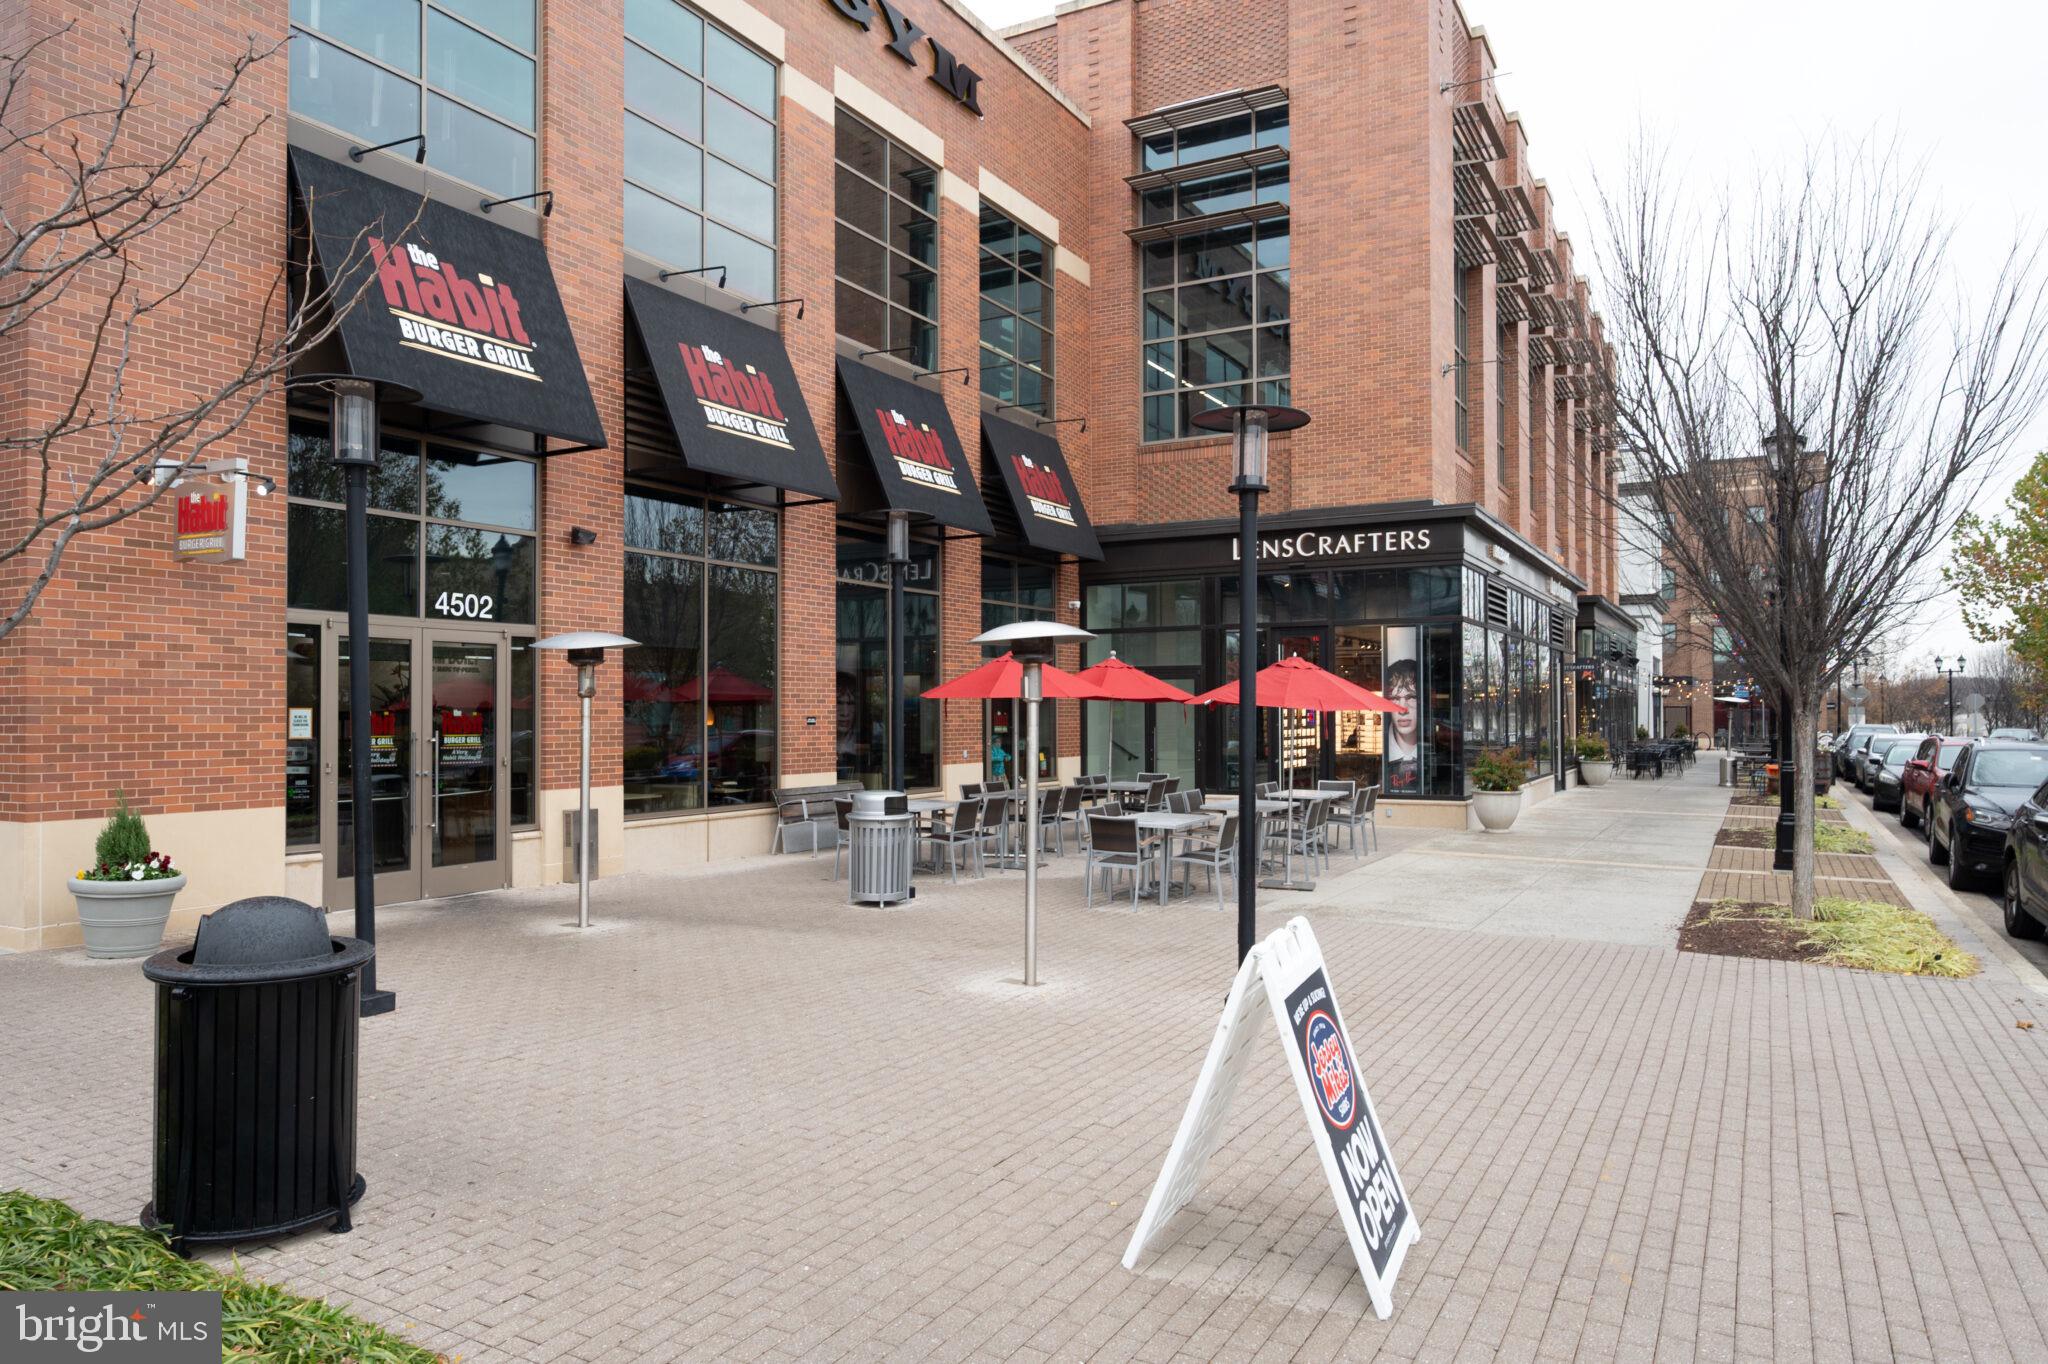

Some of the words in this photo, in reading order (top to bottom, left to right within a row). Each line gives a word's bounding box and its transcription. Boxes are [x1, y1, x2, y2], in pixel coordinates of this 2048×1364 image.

[407, 243, 440, 271] the
[367, 236, 531, 346] Habit
[399, 318, 481, 358] BURGER
[483, 342, 534, 373] GRILL
[701, 344, 723, 366] the
[677, 342, 785, 421] Habit
[703, 406, 756, 434] BURGER
[755, 421, 789, 443] GRILL
[890, 409, 907, 426] the
[875, 408, 952, 471] Habit
[898, 461, 935, 483] BURGER
[932, 471, 958, 489] GRILL
[1010, 454, 1069, 506] Habit
[178, 492, 228, 534] Habit
[190, 491, 200, 504] the
[1030, 500, 1058, 517] BURGER
[1055, 507, 1074, 522] GRILL
[179, 538, 206, 551] BURGER
[205, 537, 224, 549] GRILL
[435, 591, 493, 619] 4502
[377, 737, 393, 745] GRILL
[444, 736, 465, 745] BURGER
[466, 736, 481, 744] GRILL
[1311, 1032, 1342, 1078] Jersey
[1341, 1115, 1379, 1199] NOW
[1360, 1160, 1400, 1250] OPEN
